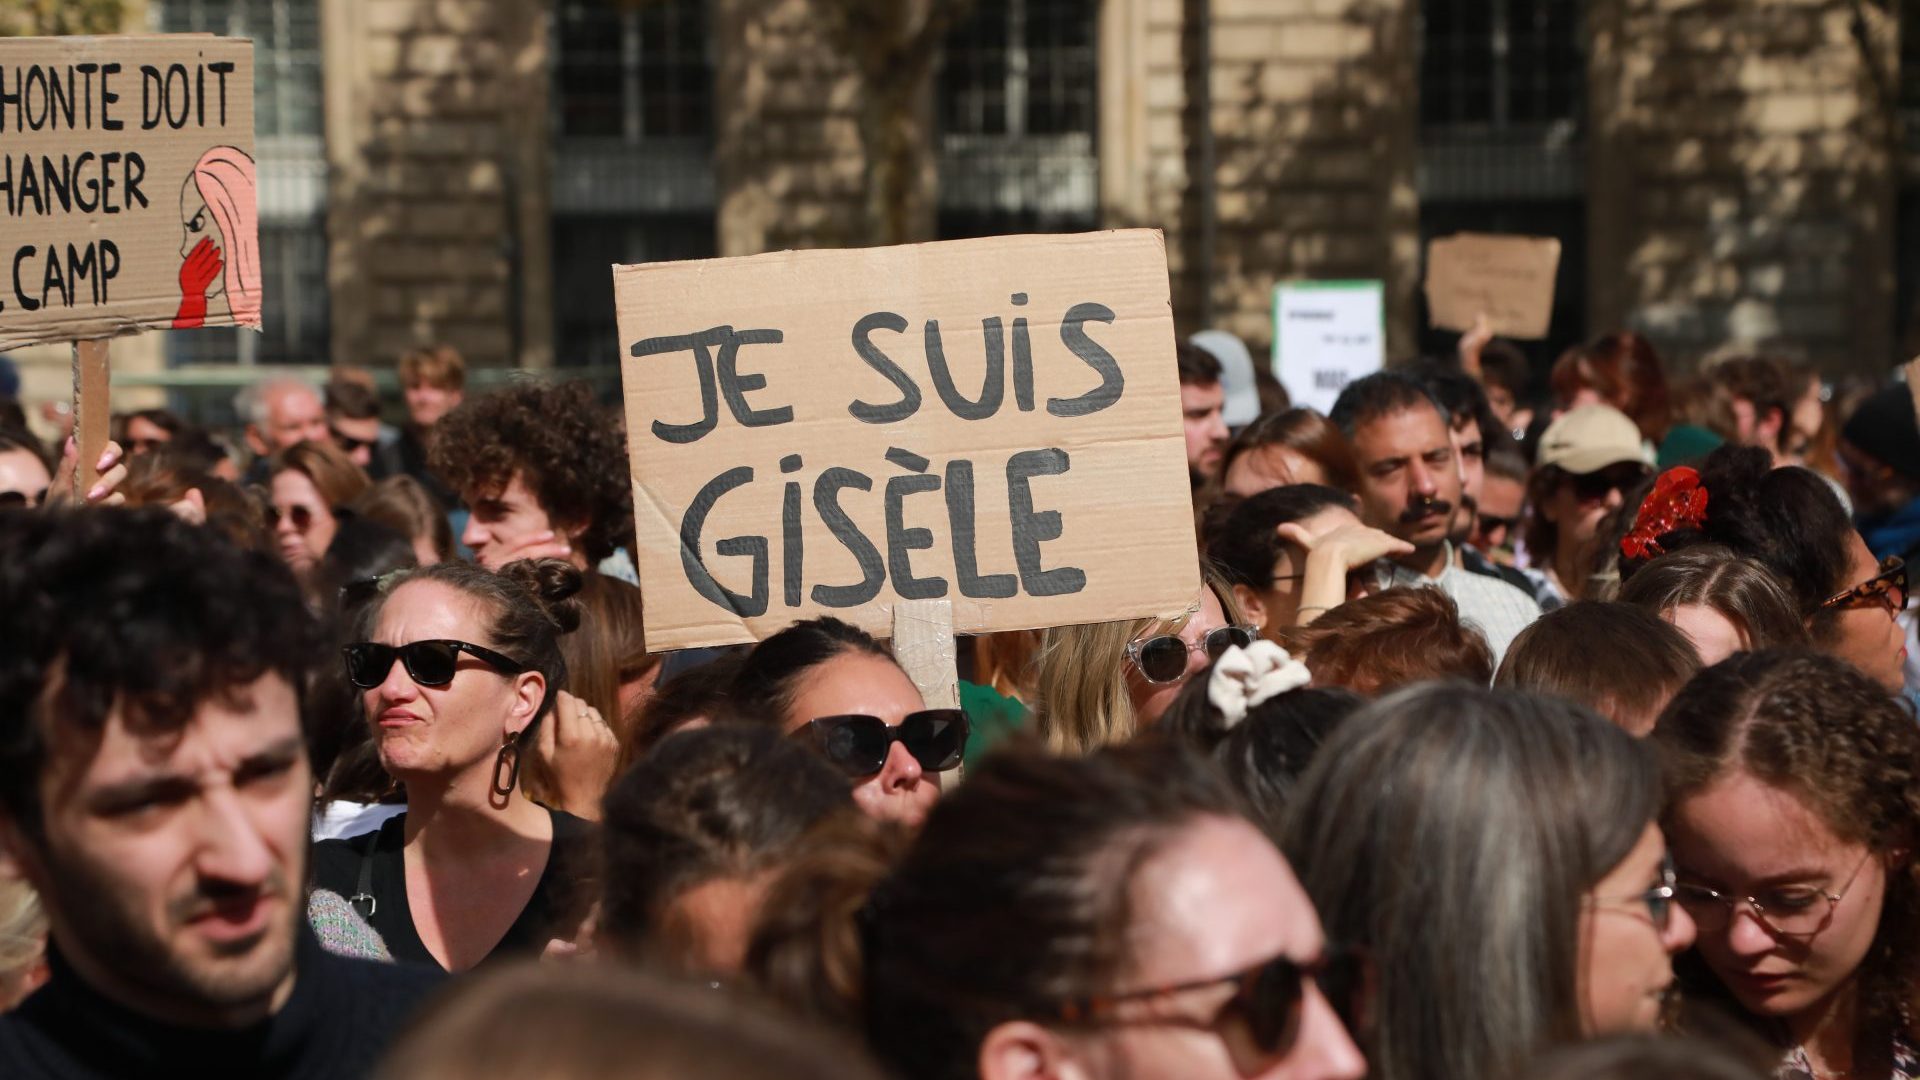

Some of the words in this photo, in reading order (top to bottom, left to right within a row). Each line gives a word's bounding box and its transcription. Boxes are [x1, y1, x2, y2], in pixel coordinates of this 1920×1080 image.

[0, 62, 124, 133] HONTE
[12, 239, 121, 312] CAMP
[631, 325, 794, 443] JE
